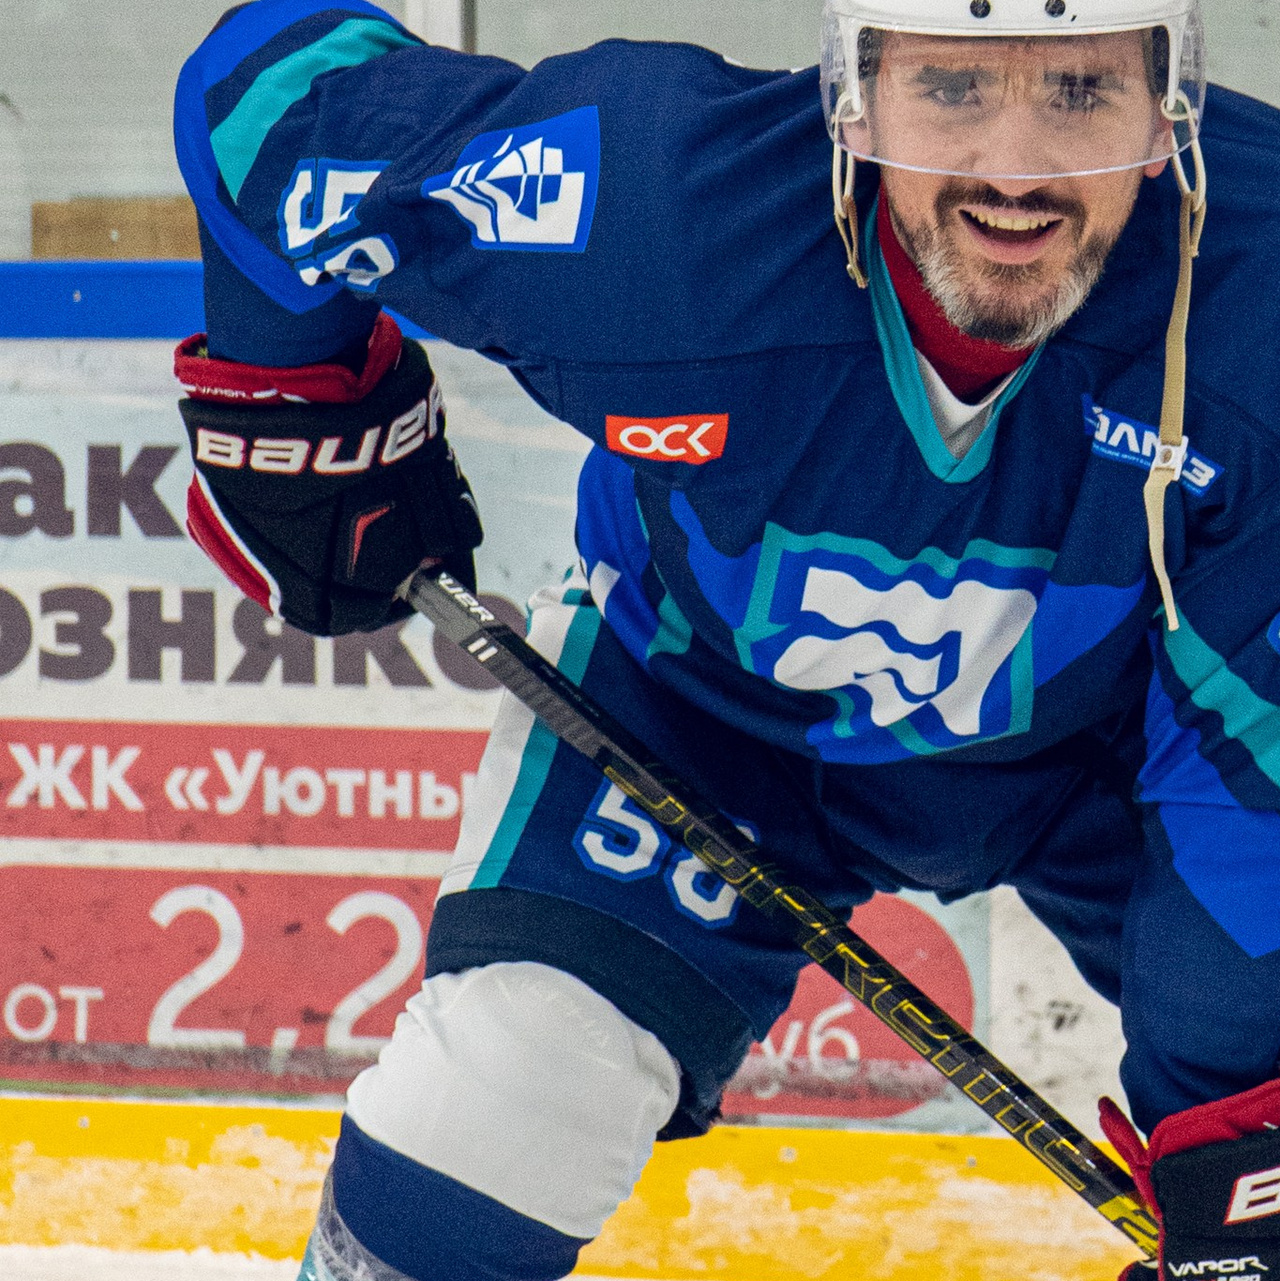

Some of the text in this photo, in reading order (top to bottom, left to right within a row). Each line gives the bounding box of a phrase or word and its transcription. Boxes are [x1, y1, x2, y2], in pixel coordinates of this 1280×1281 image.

[5, 742, 146, 812] ЖК
[3, 982, 104, 1043] от
[1168, 1256, 1268, 1277] VAPOR
